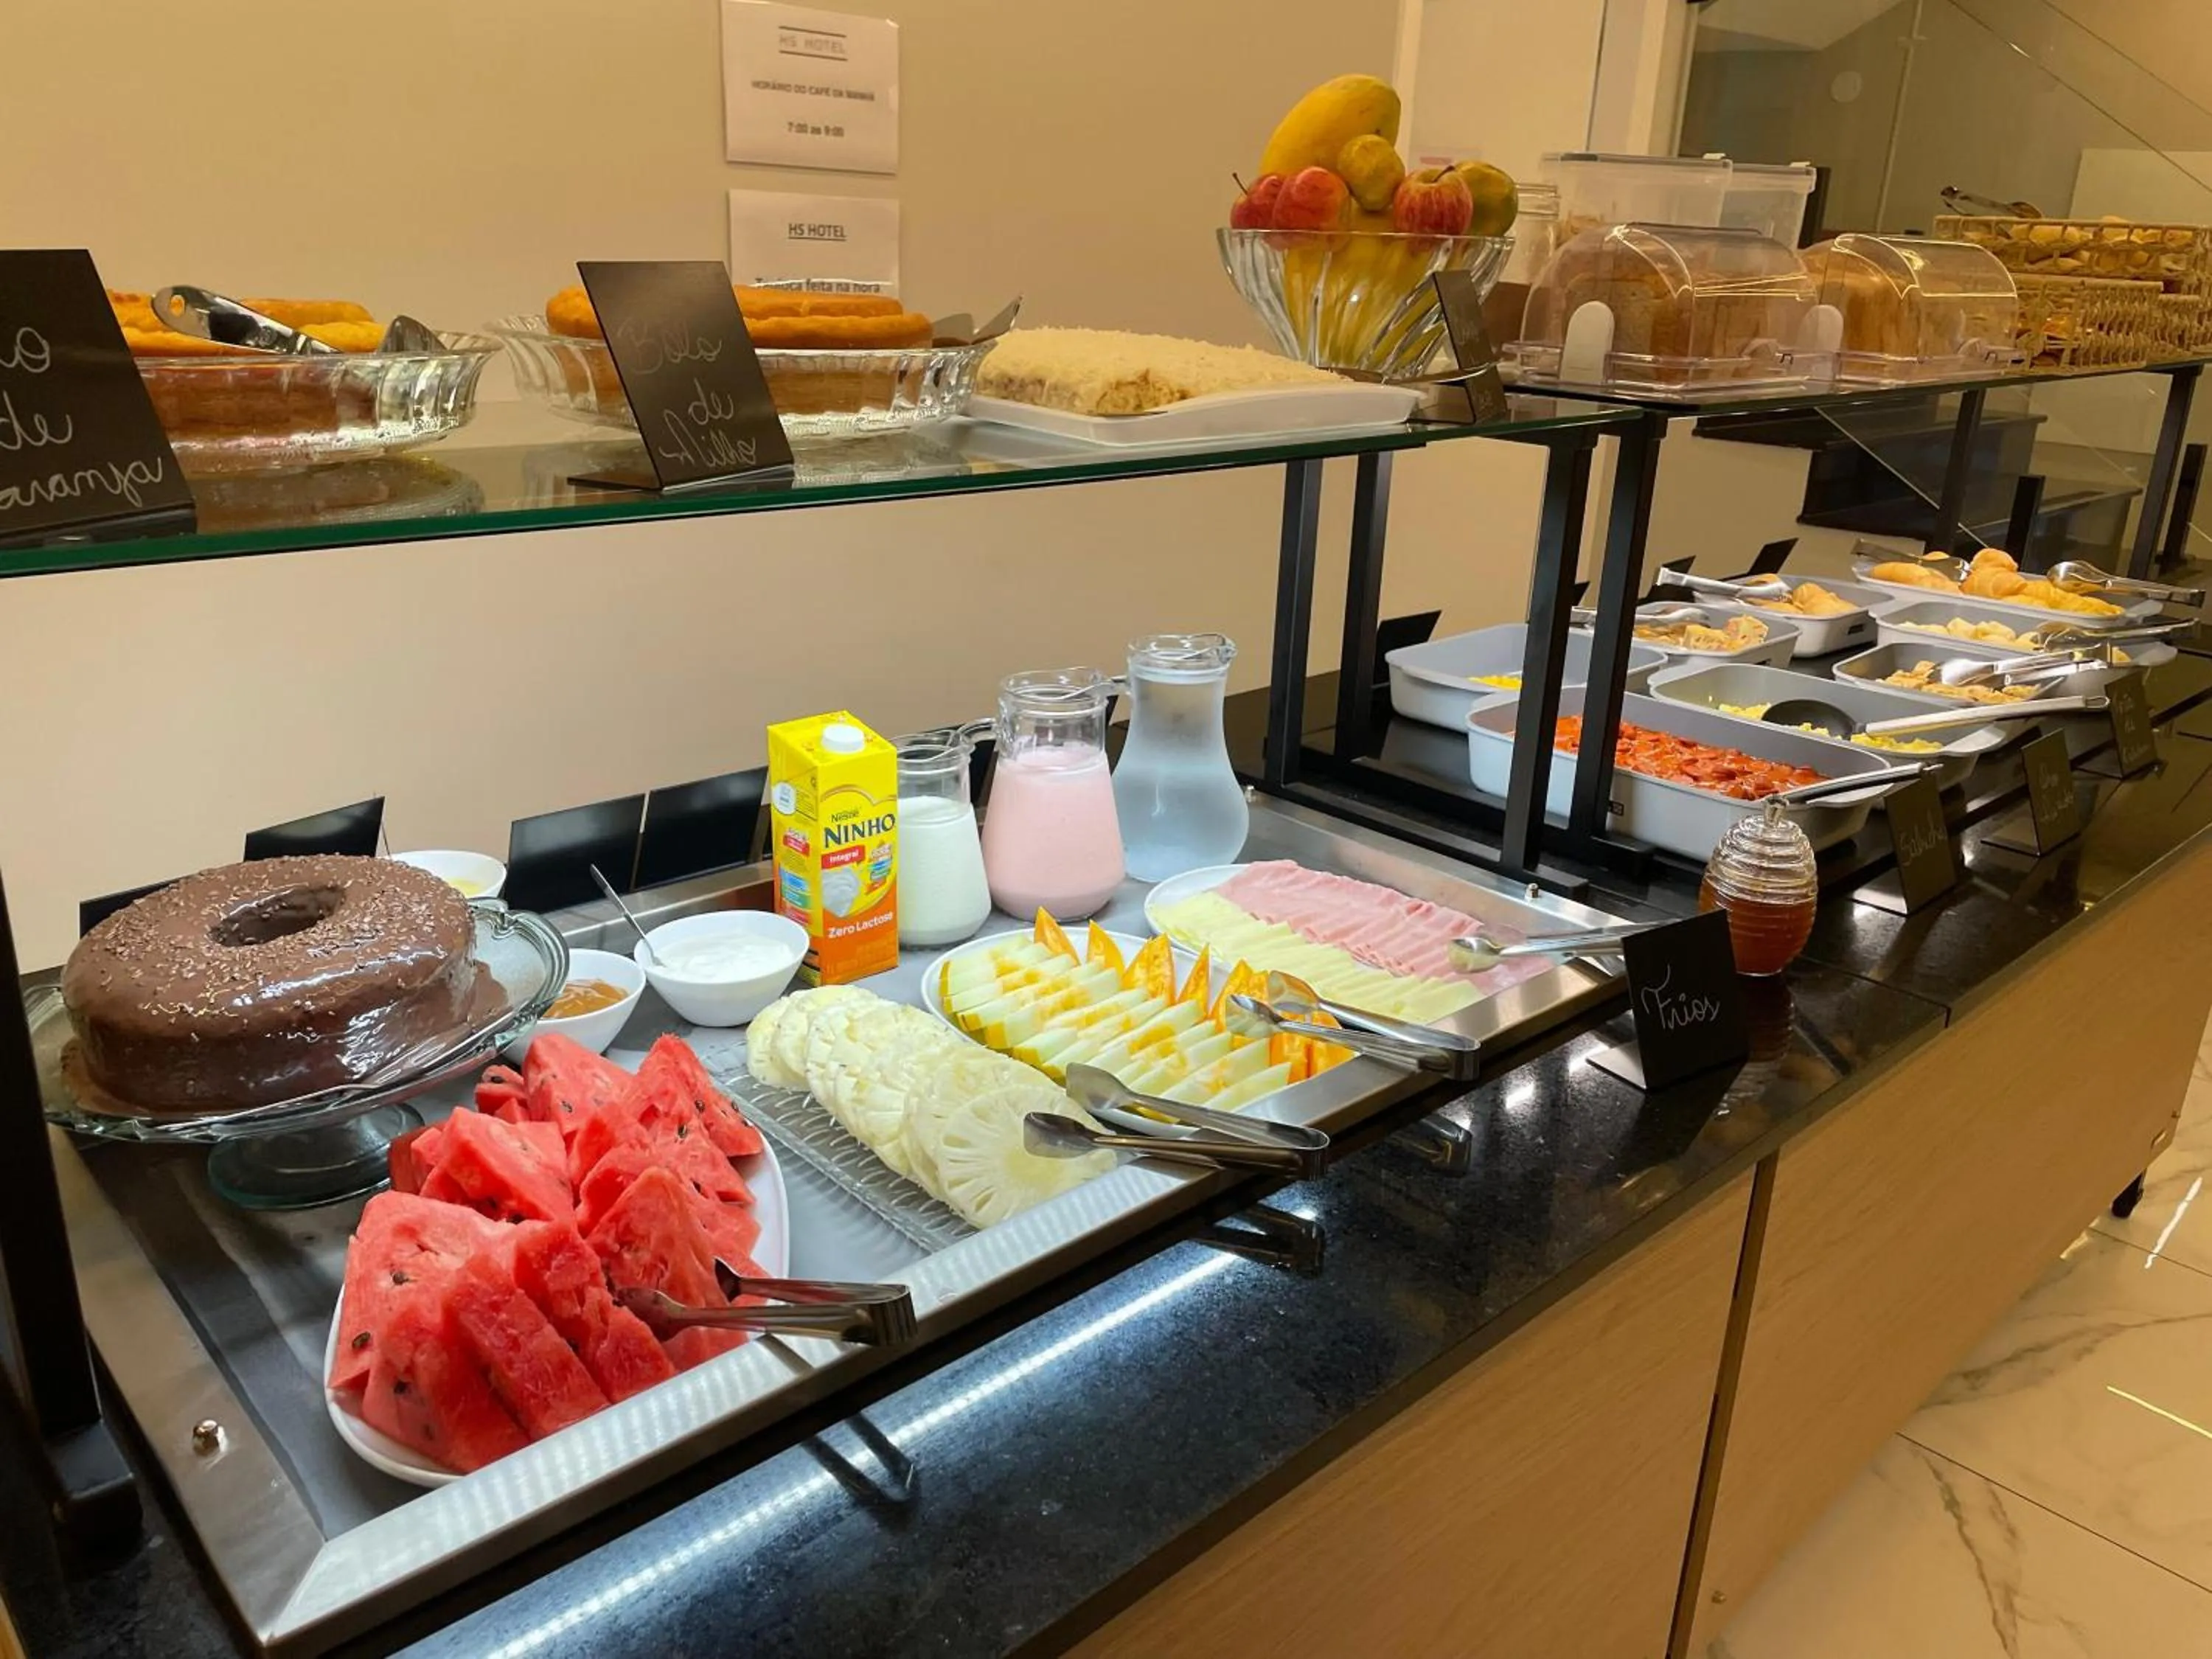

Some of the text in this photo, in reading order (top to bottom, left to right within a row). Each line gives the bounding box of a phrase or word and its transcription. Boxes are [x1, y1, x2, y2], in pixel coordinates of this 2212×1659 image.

[804, 39, 845, 54] HOTEL
[789, 223, 846, 237] HS HOTEL
[688, 378, 734, 425] de
[0, 456, 162, 509] aranja
[824, 813, 895, 848] NINHO
[828, 911, 894, 939] Zero Lactose
[1641, 964, 1721, 1029] Frios
